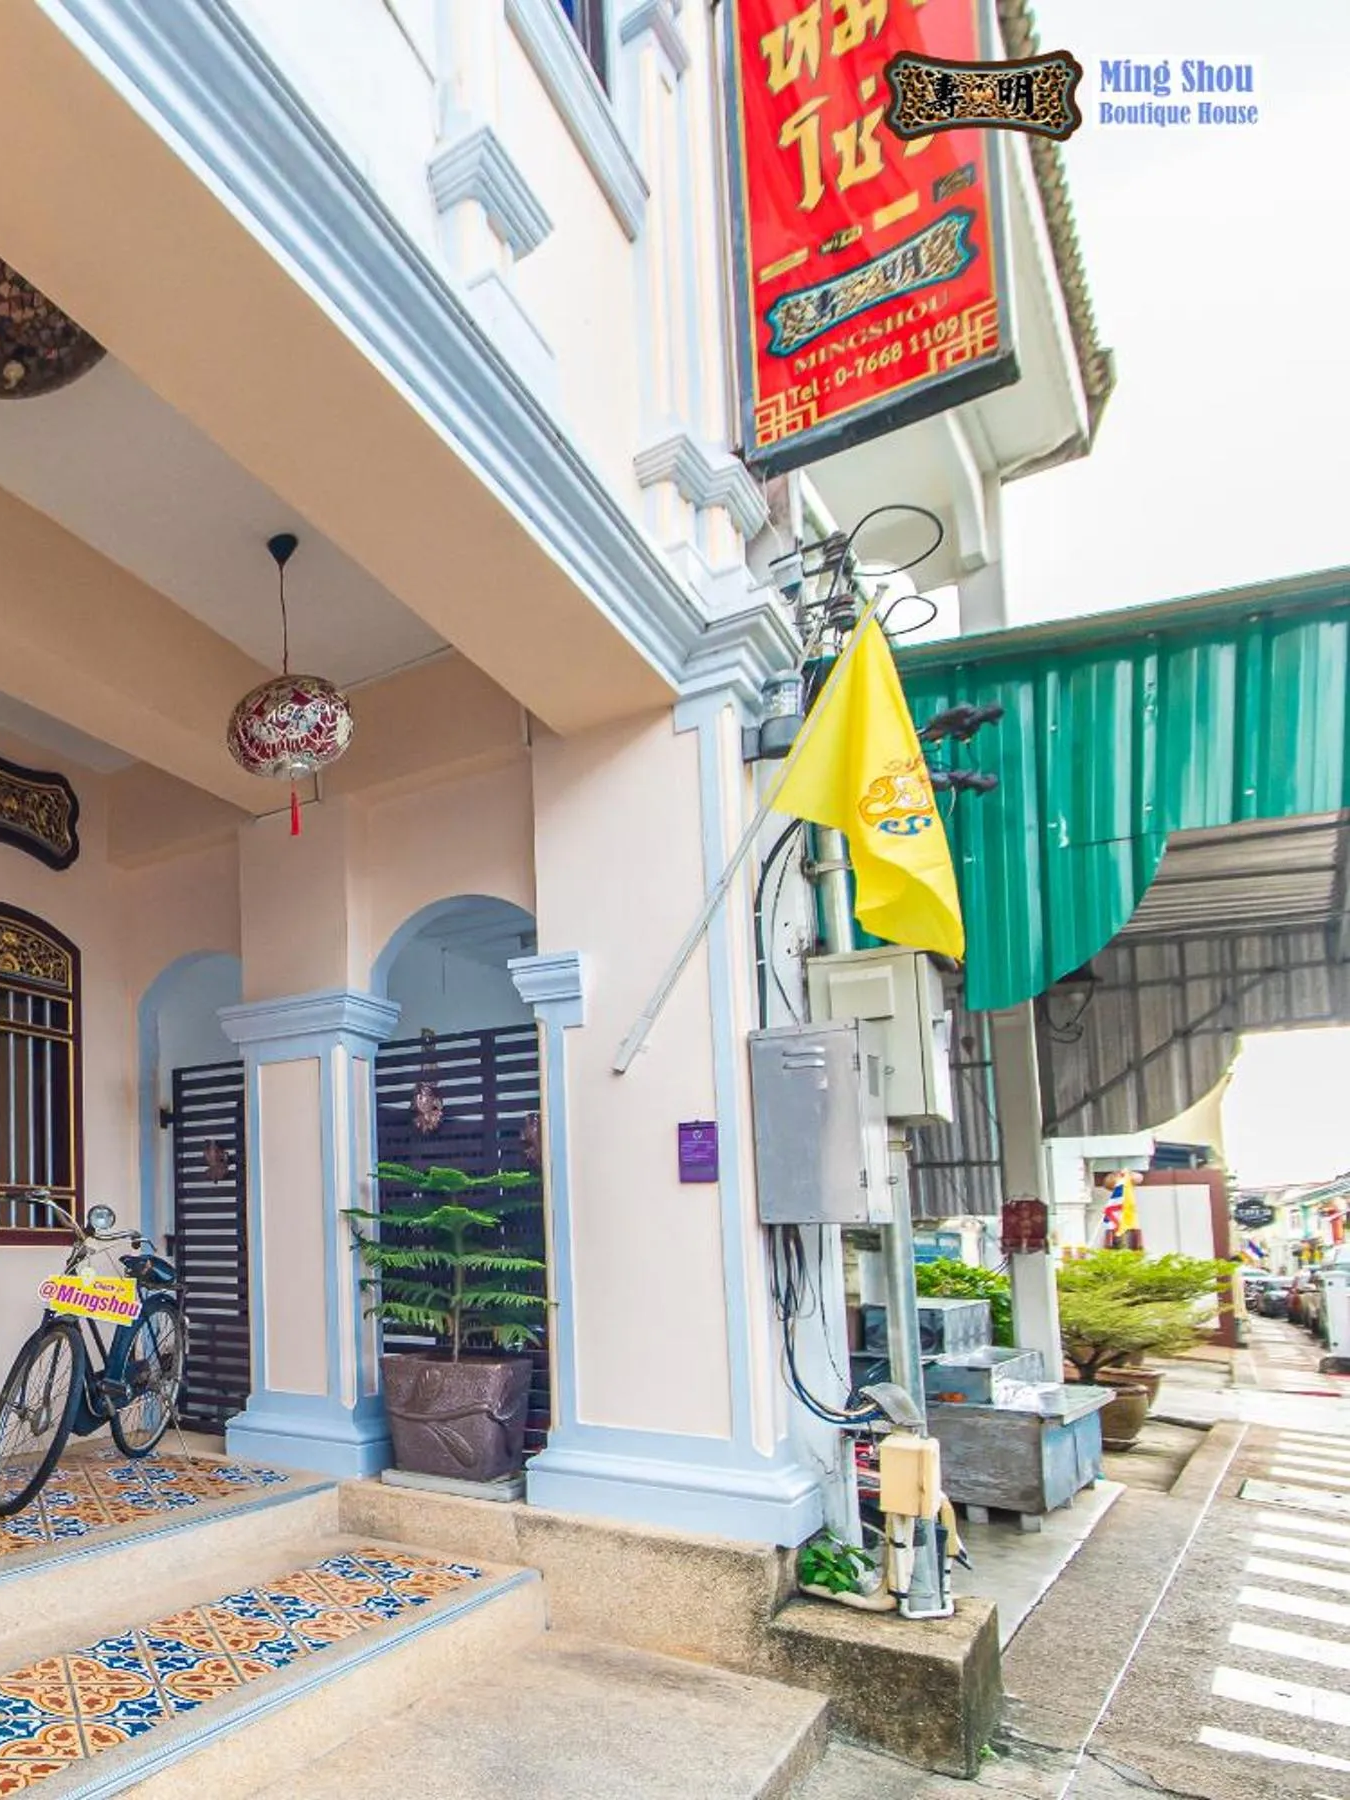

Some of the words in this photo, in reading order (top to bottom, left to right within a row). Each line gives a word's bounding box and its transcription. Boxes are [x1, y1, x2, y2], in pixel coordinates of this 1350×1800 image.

[787, 376, 819, 405] Tel
[834, 341, 904, 388] 0-7668
[908, 314, 961, 351] 1109
[794, 289, 949, 375] MINGSHOU
[40, 1280, 140, 1317] @Mingshou
